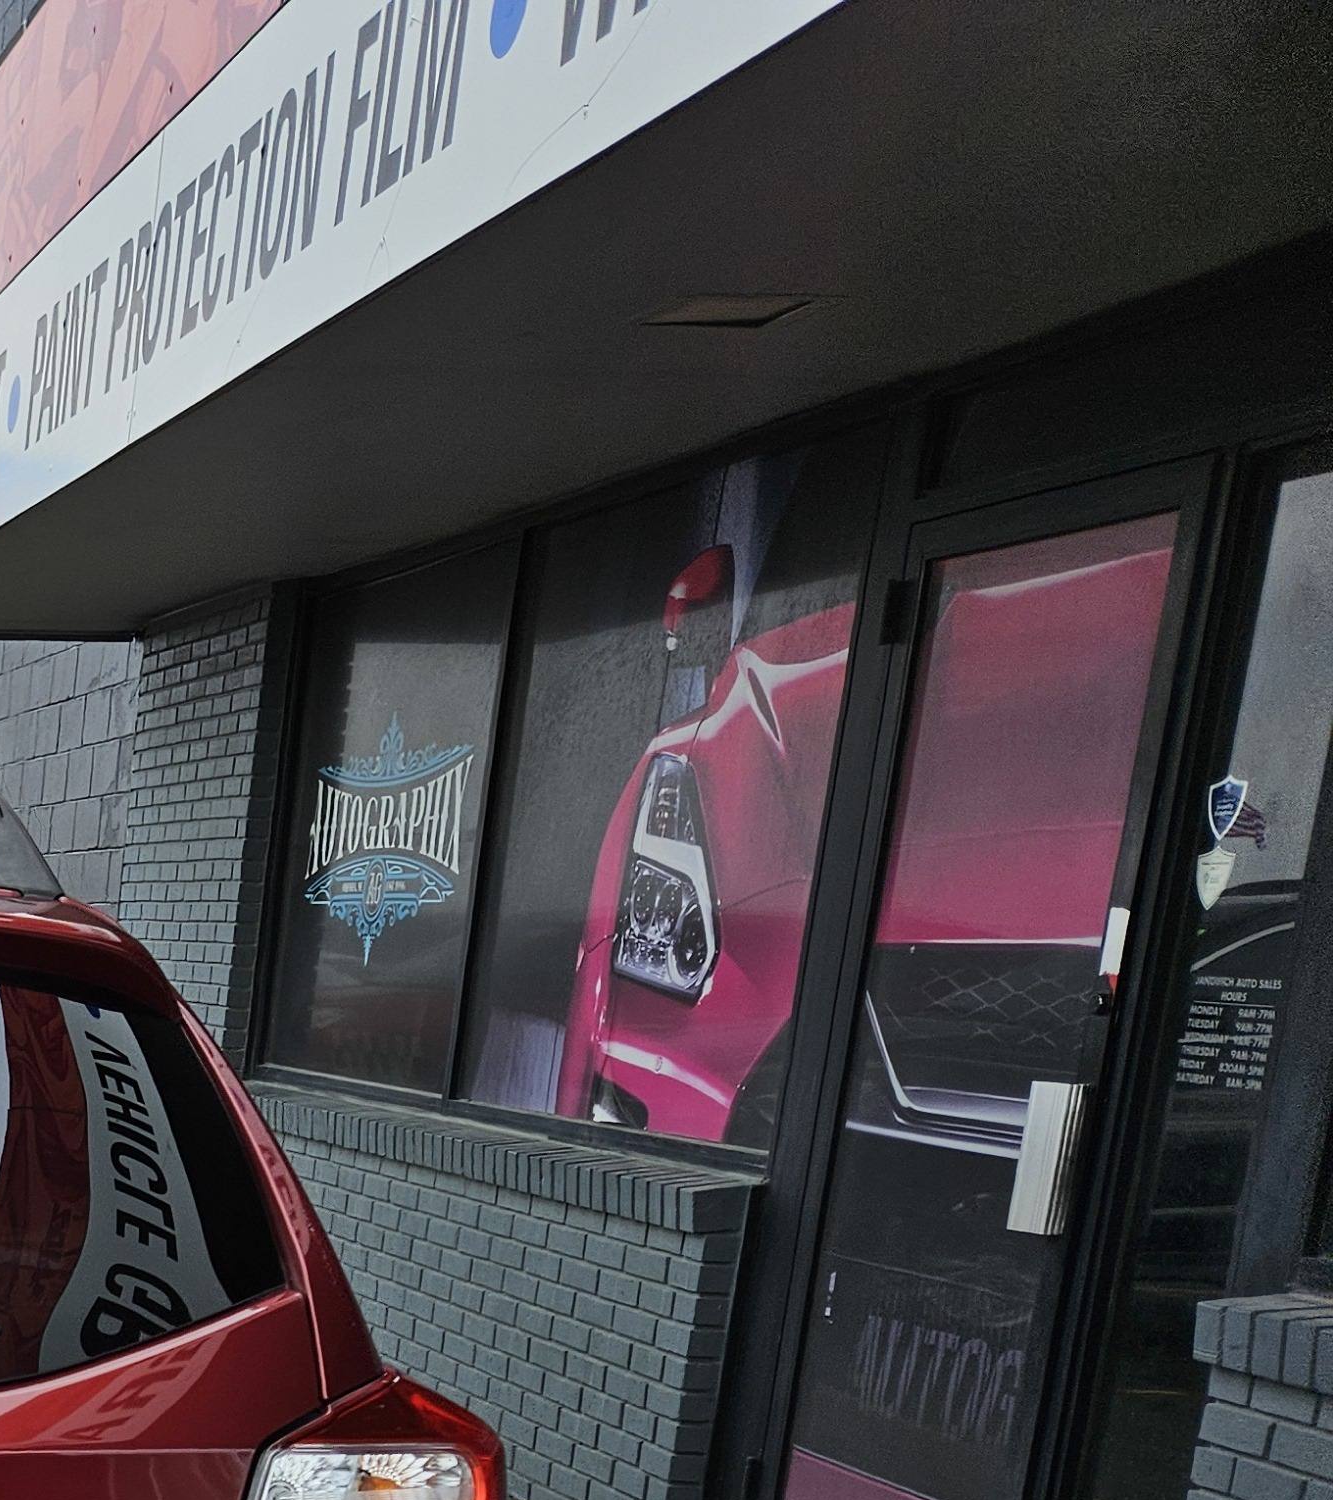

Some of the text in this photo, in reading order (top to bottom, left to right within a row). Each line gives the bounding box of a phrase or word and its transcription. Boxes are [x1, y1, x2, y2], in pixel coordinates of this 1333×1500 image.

[24, 258, 109, 451] PAINT
[103, 50, 336, 395] PROTECTION
[334, 0, 470, 227] FILM
[304, 753, 474, 880] AUTOGRAPHIX
[1235, 978, 1258, 989] AUTO
[1258, 979, 1282, 990] SALES
[1220, 991, 1247, 1002] HOURS
[1189, 1005, 1276, 1020] MONDAY 9AM-7PM
[1187, 1018, 1220, 1029] TUESDAY
[1181, 1045, 1268, 1062] THURSDAY 9AM-7PM
[1177, 1058, 1206, 1070] FRIDAY
[1175, 1072, 1215, 1085] SATURDAY
